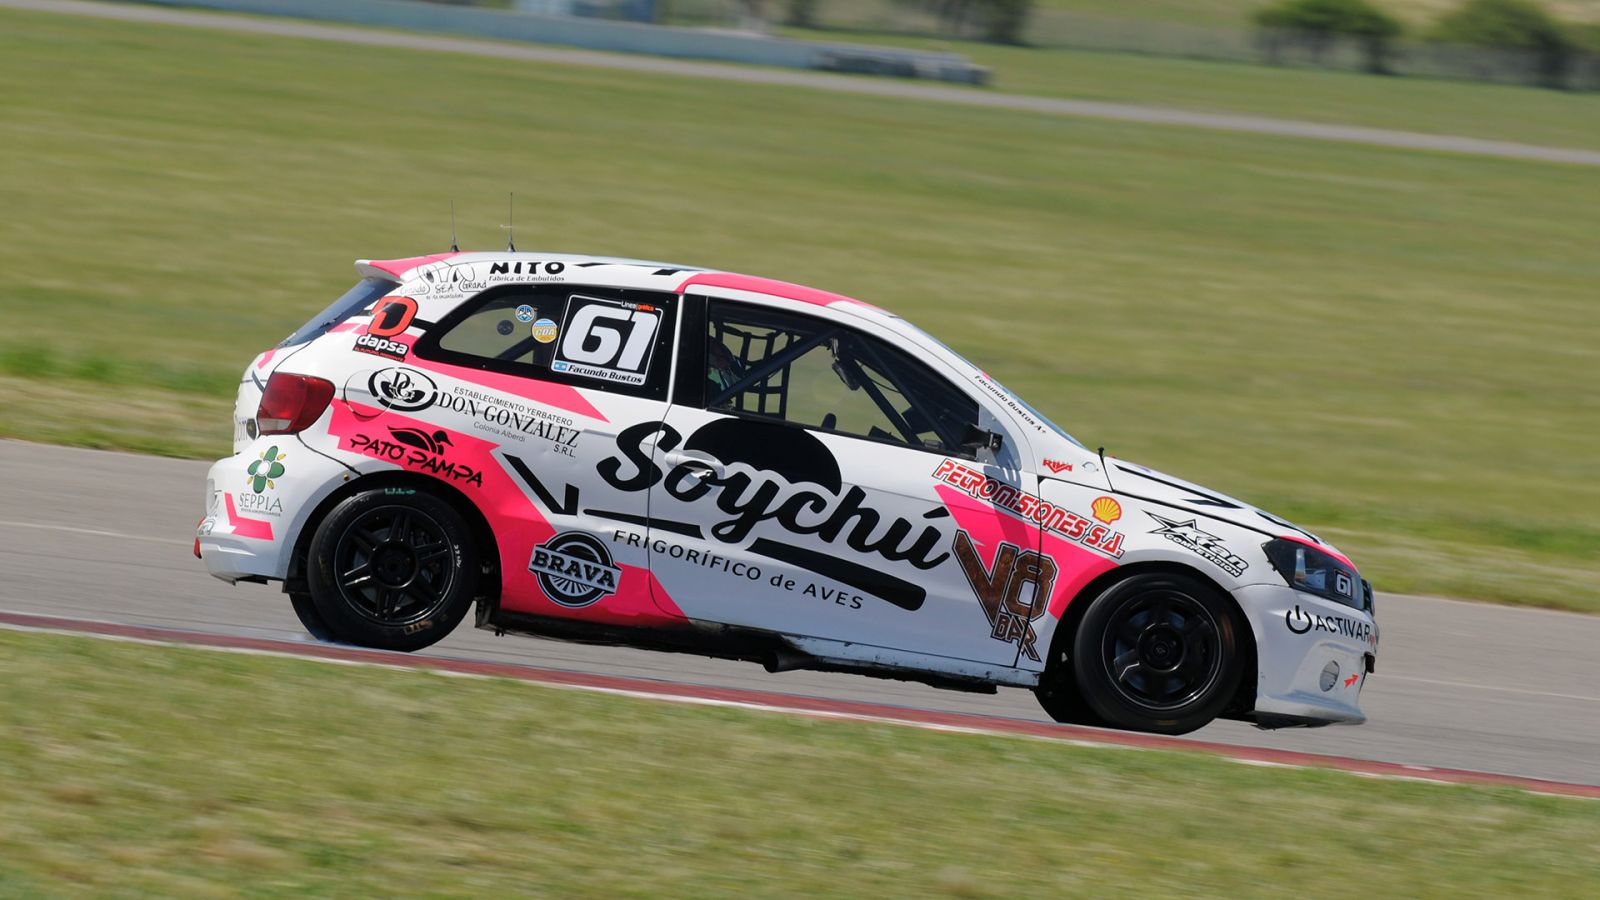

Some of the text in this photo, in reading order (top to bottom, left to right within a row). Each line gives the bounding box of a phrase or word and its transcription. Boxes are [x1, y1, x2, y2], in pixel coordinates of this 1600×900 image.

[489, 262, 565, 275] NITO
[357, 334, 408, 355] dapsa
[562, 304, 658, 371] 61
[568, 365, 642, 384] Facundo Bustos
[438, 392, 581, 448] DON GONZALEZ
[454, 386, 573, 427] ESTABLECIMIENTO YERBATERO
[974, 375, 1008, 402] Facundo
[1007, 401, 1035, 427] Bustos
[473, 421, 526, 443] Colonia Alberdi
[553, 444, 576, 459] S.R.L.
[350, 433, 483, 488] PATO PAMPA
[239, 492, 283, 513] SEPPIA
[596, 420, 951, 570] Soychú
[1083, 525, 1123, 557] S.A.
[531, 550, 616, 589] BRAVA
[613, 528, 864, 610] FRIGORÍFICO de AVES
[952, 529, 1058, 628] V8
[1336, 573, 1352, 597] 61
[990, 612, 1043, 662] BAR
[1315, 616, 1370, 643] ACTIVAR
